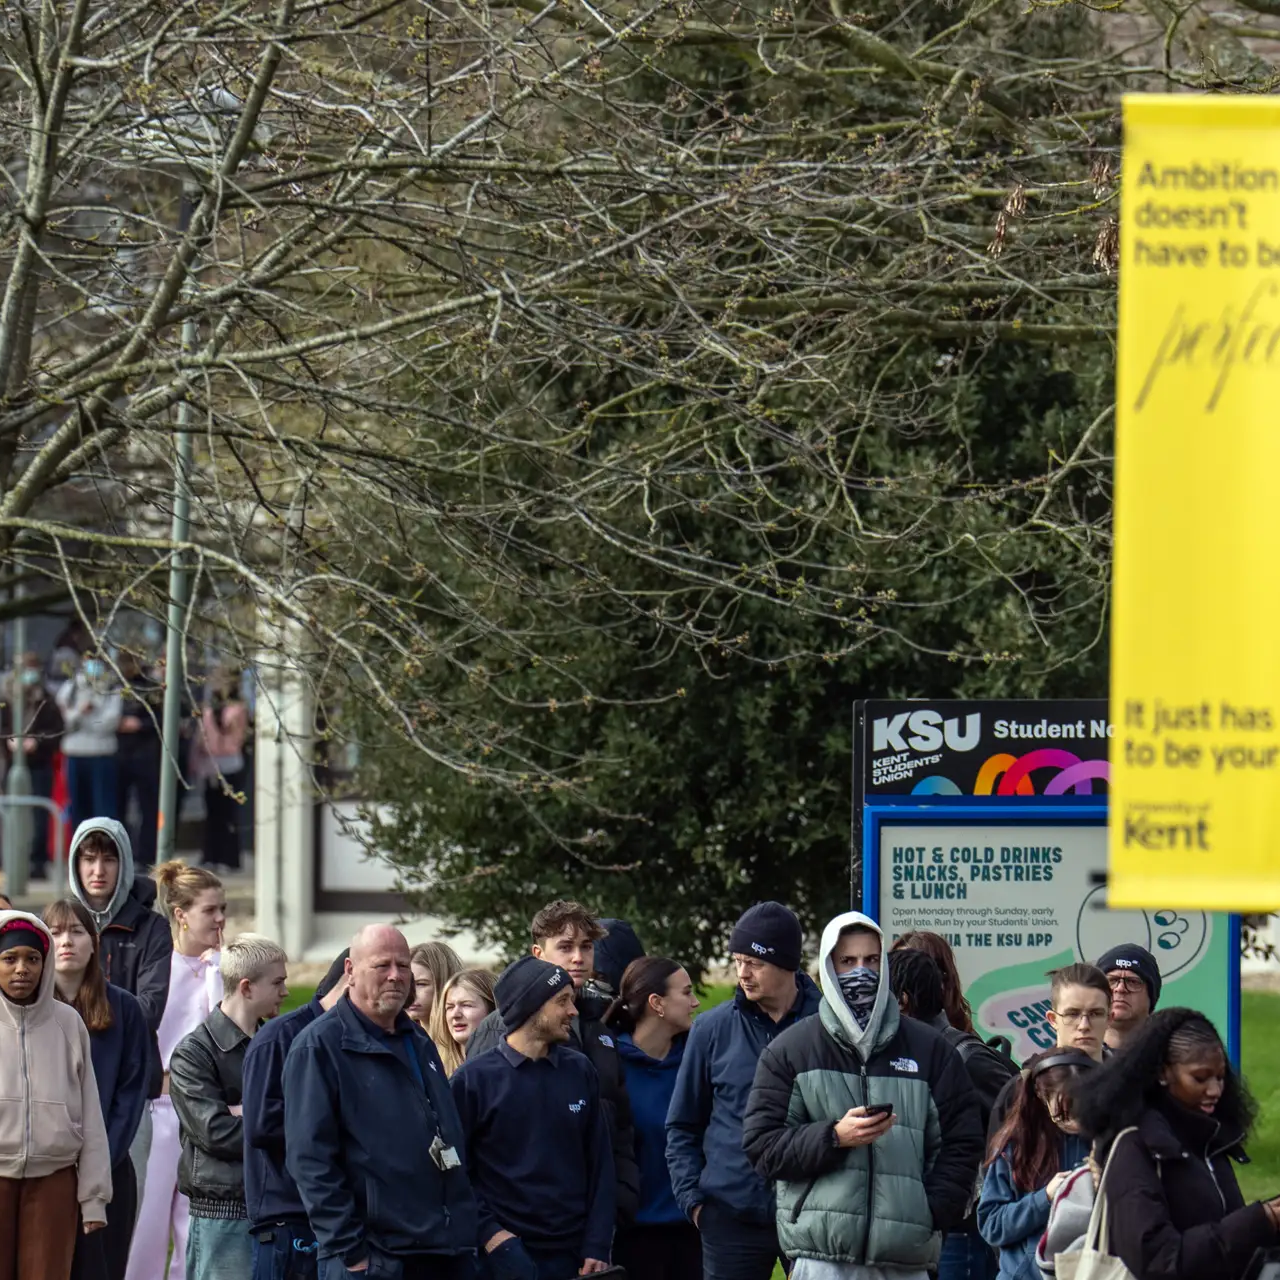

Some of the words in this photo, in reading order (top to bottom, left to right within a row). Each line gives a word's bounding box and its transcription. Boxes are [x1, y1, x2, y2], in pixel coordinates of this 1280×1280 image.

[1136, 162, 1279, 191] Ambition
[1134, 200, 1247, 229] doesn't
[1134, 240, 1208, 267] have
[1219, 243, 1249, 267] to
[1125, 699, 1146, 728] It
[1152, 700, 1211, 736] just
[1221, 700, 1274, 730] has
[873, 710, 982, 752] KSU
[994, 719, 1086, 739] Student
[872, 752, 910, 769] KENT
[1124, 740, 1155, 768] to
[1164, 740, 1202, 768] be
[872, 754, 943, 777] STUDENTS'
[872, 769, 913, 786] UNION
[1124, 817, 1210, 851] Kent
[893, 847, 926, 863] HOT
[932, 847, 944, 863] &
[950, 847, 994, 863] COLD
[1001, 847, 1063, 863] DRINKS
[970, 865, 1053, 881] PASTRIES
[892, 883, 905, 899] &
[911, 883, 967, 899] LUNCH
[892, 907, 916, 917] Open
[918, 907, 955, 917] Monday
[956, 907, 992, 917] through
[1031, 907, 1054, 917] early
[892, 918, 912, 926] until
[953, 918, 964, 928] by
[966, 919, 986, 928] your
[1031, 918, 1059, 926] Union.
[966, 933, 992, 946] THE
[997, 933, 1022, 946] KSU
[1027, 933, 1053, 946] APP
